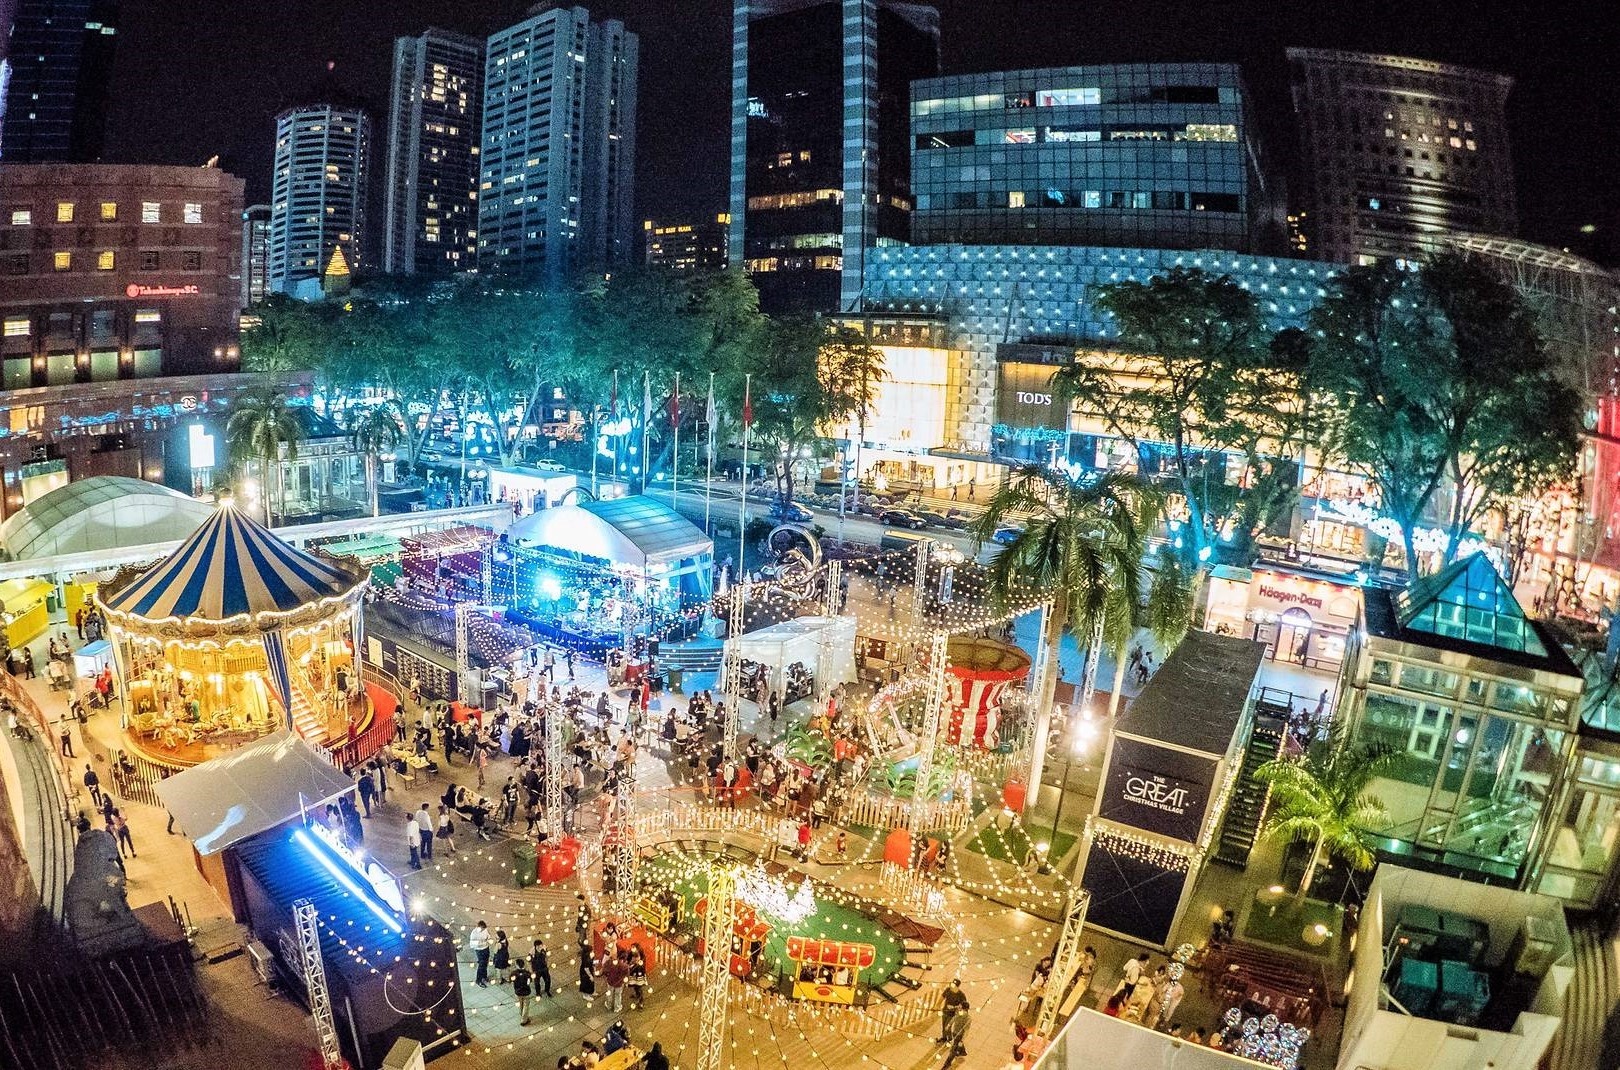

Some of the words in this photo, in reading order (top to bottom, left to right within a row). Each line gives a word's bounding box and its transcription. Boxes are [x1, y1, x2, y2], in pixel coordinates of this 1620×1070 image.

[1016, 391, 1052, 405] TOD'S
[1153, 775, 1166, 784] THE
[1126, 777, 1189, 808] GREAT
[1123, 794, 1158, 808] CHRISTMAS
[1158, 803, 1184, 815] VILLAGE
